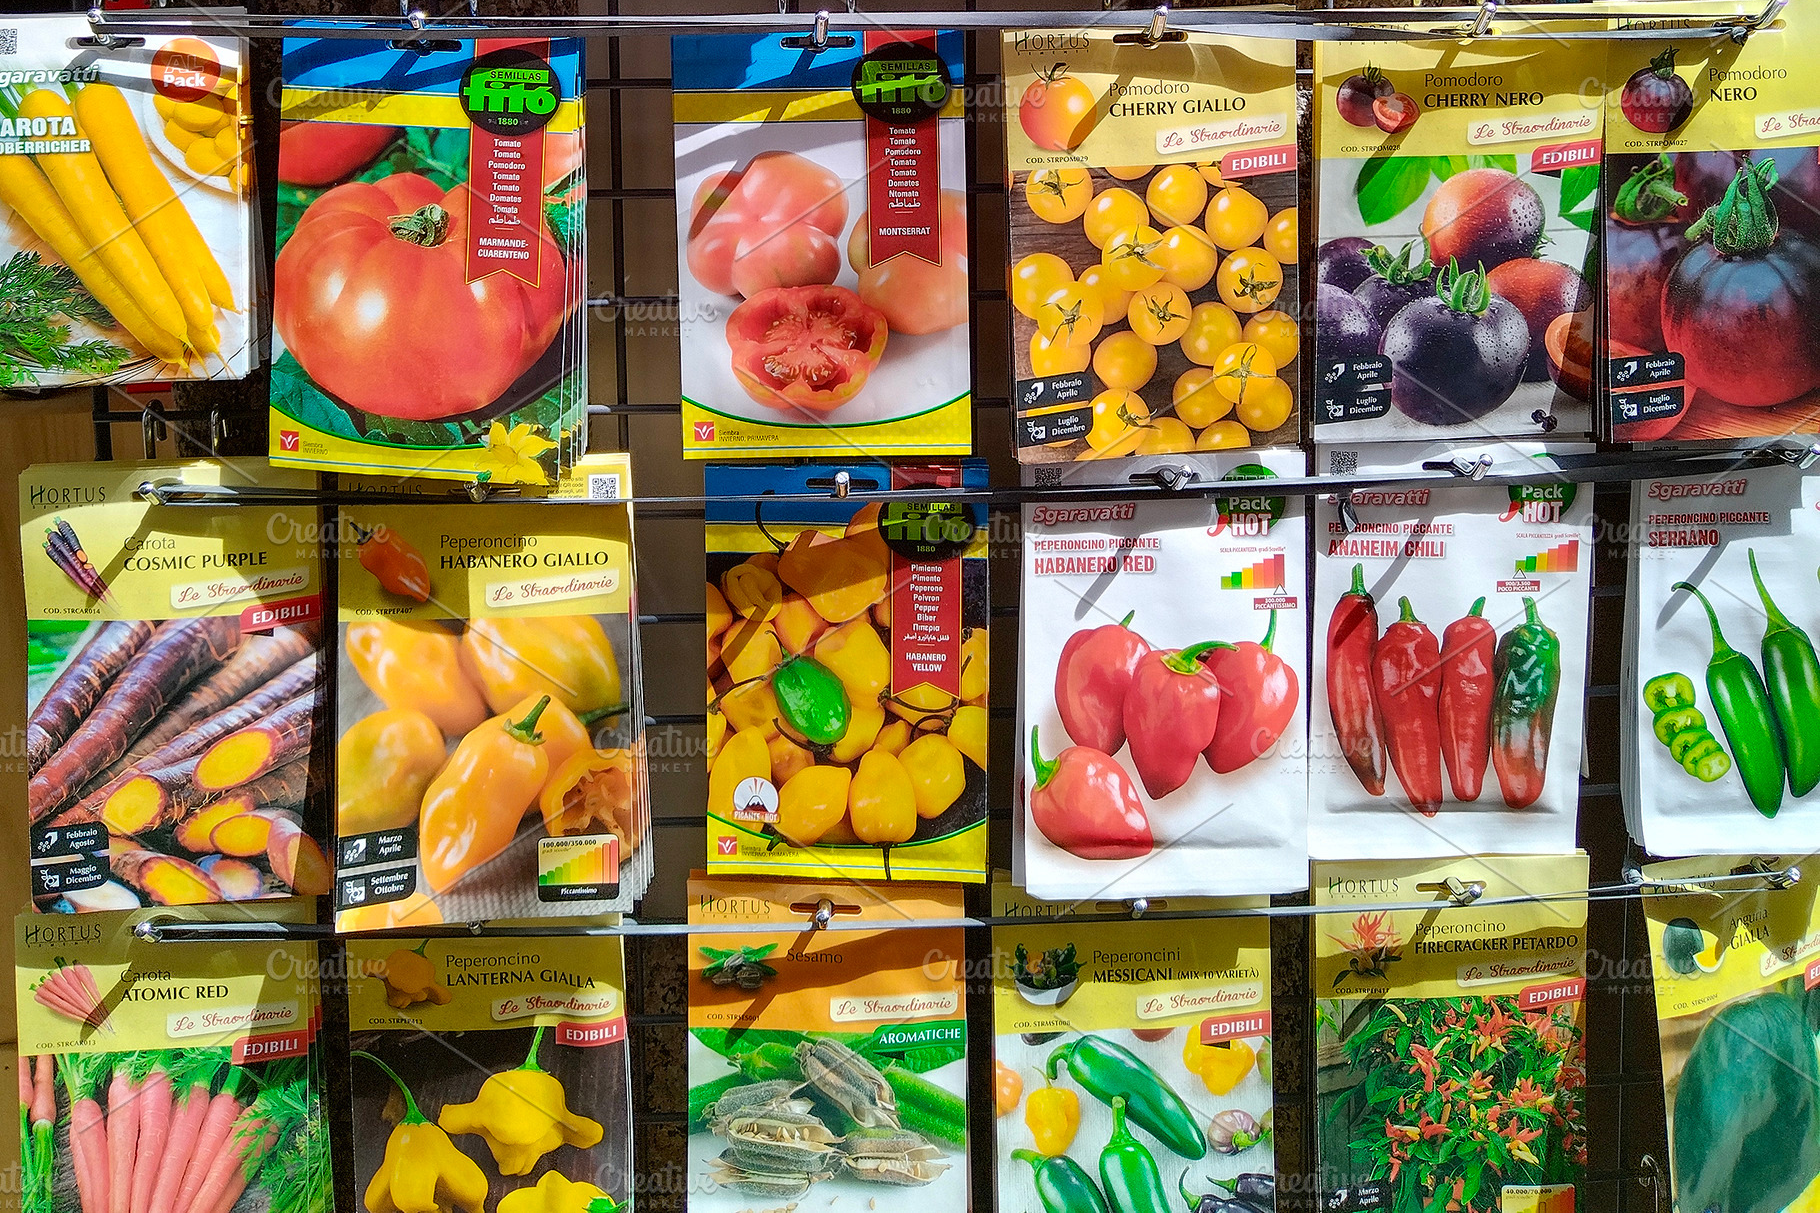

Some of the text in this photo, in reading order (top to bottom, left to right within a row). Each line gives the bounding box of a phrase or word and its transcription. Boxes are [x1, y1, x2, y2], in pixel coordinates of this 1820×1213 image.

[881, 62, 931, 71] SEMILLAS
[1709, 65, 1787, 82] Pomodoro
[163, 72, 206, 87] Pack
[490, 71, 541, 81] SEMILLAS
[1424, 72, 1503, 88] Pomodoro
[1110, 81, 1190, 96] Pomodoro
[1710, 87, 1757, 102] NERO
[1109, 97, 1246, 117] CHERRY GIALLO
[1424, 91, 1544, 108] CHERRY NERO
[498, 117, 518, 126] 1880
[1474, 115, 1592, 140] Le Straordinarie
[1163, 121, 1281, 149] Le Straordinarie
[1232, 153, 1287, 171] EDIBILI
[1542, 147, 1595, 165] EDIBILI
[490, 193, 522, 203] Domates
[889, 190, 919, 198] Ntomata
[879, 227, 931, 236] MONTSERRAT
[479, 238, 528, 248] MARMANDE-
[478, 249, 530, 260] CUARENTENO
[1052, 378, 1082, 390] Febbraio
[1521, 485, 1563, 500] Pack
[1648, 479, 1746, 502] Sgaravatti
[1229, 496, 1271, 511] Pack
[1523, 501, 1563, 523] HOT
[1033, 503, 1136, 525] Sgaravatti
[1648, 512, 1770, 525] PEPERONCINO PICCANTE
[1231, 513, 1271, 537] HOT
[1403, 523, 1453, 535] PICCANTE
[124, 537, 175, 552] Carota
[440, 534, 537, 552] Peperoncino
[1034, 537, 1159, 552] PEPERONCINO PICCANTE
[1648, 529, 1719, 547] SERRANO
[1328, 538, 1445, 557] ANAHEIM CHILI
[124, 552, 267, 572] COSMIC PURPLE
[440, 551, 609, 569] HABANERO GIALLO
[911, 564, 942, 572] Pimiento
[1034, 555, 1155, 575] HABANERO RED
[493, 576, 614, 602] Le Straordinarie
[913, 594, 940, 602] Poivron
[252, 603, 310, 625] EDIBILI
[917, 614, 936, 622] Biber
[906, 652, 947, 662] HABANERO
[912, 663, 942, 672] YELLOW
[70, 839, 95, 850] Agosto
[542, 840, 597, 848] 100.000/350.000
[370, 873, 409, 885] Settembre
[561, 887, 598, 896] Piccantissimo
[1415, 920, 1506, 938] Peperoncino
[1730, 925, 1770, 949] GIALLA
[1415, 935, 1578, 955] FIRECRACKER PETARDO
[446, 954, 541, 971] Peperoncino
[787, 948, 843, 963] Sesamo
[1093, 947, 1180, 967] Peperoncini
[120, 969, 171, 983] Carota
[447, 969, 595, 989] LANTERNA GIALLA
[1093, 967, 1260, 983] MESSICANI (MIX 10 VARIETÀ)
[120, 985, 228, 1002] ATOMIC RED
[1143, 988, 1257, 1014] Le Straordinarie
[1528, 984, 1579, 1003] EDIBILI
[498, 995, 611, 1015] Le Straordinarie
[174, 1007, 292, 1032] Le Straordinarie
[1211, 1018, 1263, 1036] EDIBILI
[566, 1025, 617, 1041] EDIBILI
[880, 1028, 961, 1045] AROMATICHE
[243, 1039, 298, 1058] EDIBILI
